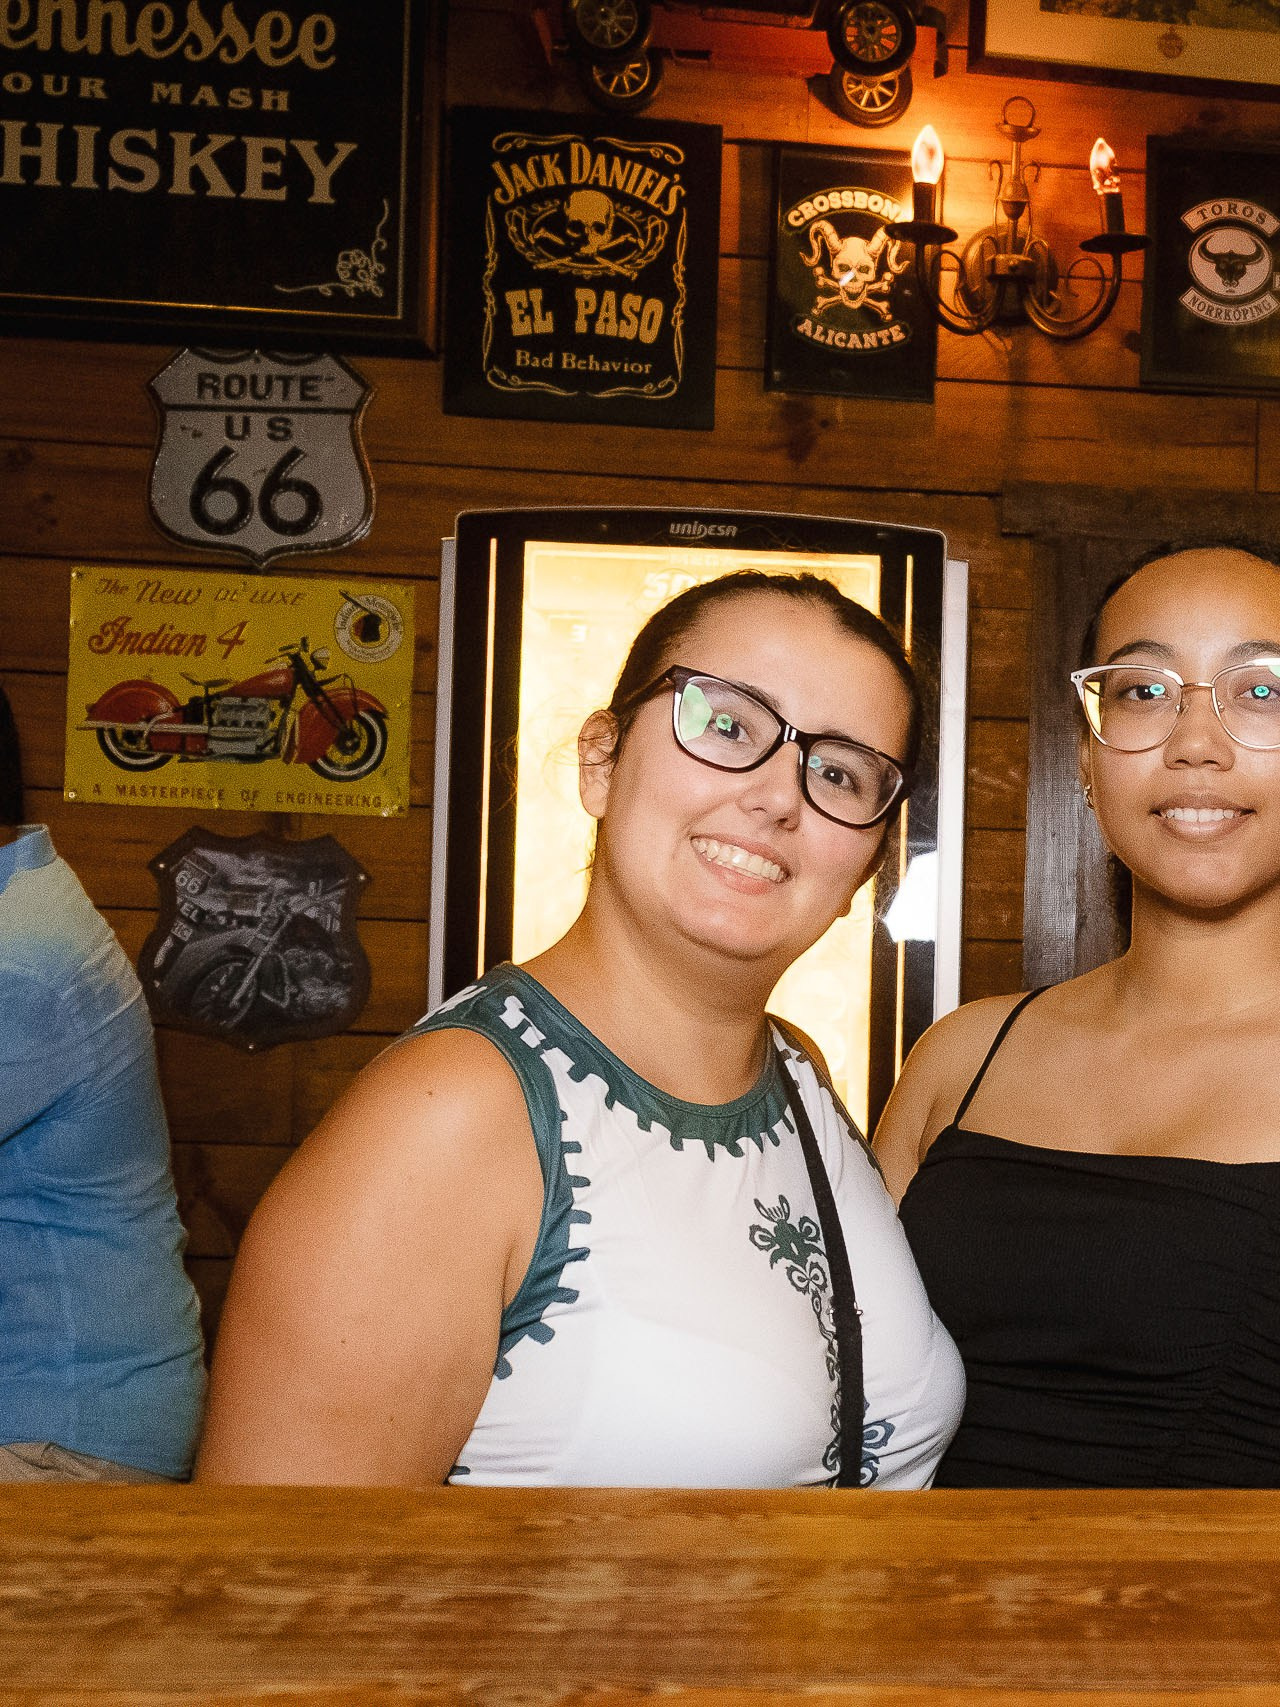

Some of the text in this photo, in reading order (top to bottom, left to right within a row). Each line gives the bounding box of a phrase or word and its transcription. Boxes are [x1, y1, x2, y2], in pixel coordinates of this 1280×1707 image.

[151, 82, 291, 112] MASH
[491, 141, 686, 216] JACK DANIEL'S
[1197, 202, 1267, 225] TOROS
[505, 287, 664, 344] EL PASO
[1189, 295, 1273, 321] NORRKÖPING
[797, 318, 905, 349] ALICANTE
[515, 350, 652, 374] Bad Behavior
[197, 372, 321, 401] ROUTE
[189, 446, 324, 536] 66
[96, 578, 129, 596] The
[136, 579, 203, 605] New
[87, 616, 250, 660] Indian 4
[93, 784, 382, 808] A MASTERPIECE OF ENGINEERING
